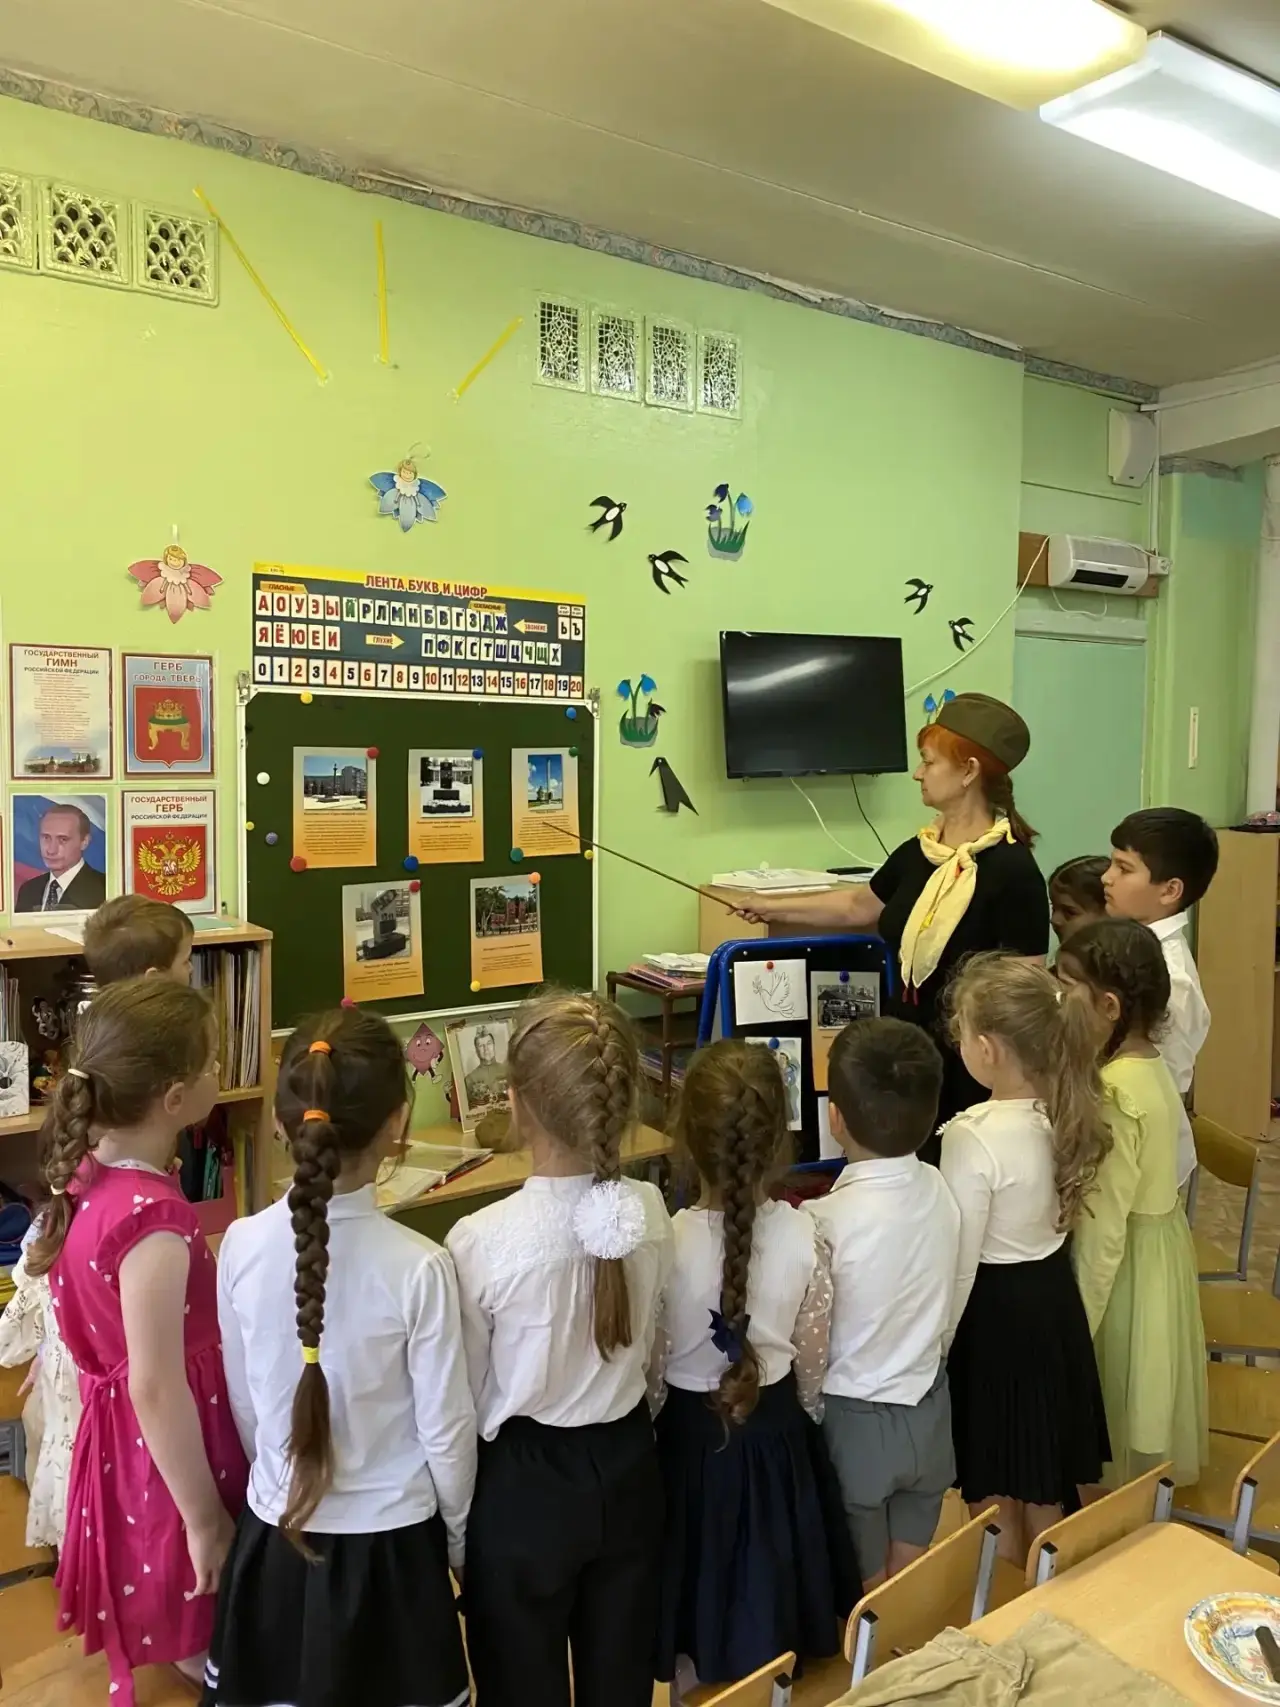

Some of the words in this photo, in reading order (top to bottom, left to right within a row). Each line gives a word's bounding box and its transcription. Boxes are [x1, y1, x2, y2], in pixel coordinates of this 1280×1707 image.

[366, 575, 404, 590] ЛЕНТА
[409, 580, 439, 594] БУКВ
[443, 584, 450, 594] И
[454, 584, 488, 597] ЦИФР
[259, 595, 268, 611] А
[276, 596, 286, 612] О
[295, 598, 304, 613] У
[312, 600, 320, 614] Э
[327, 601, 338, 616] Ы
[362, 604, 371, 619] Р
[377, 605, 386, 620] Л
[392, 607, 402, 622] М
[409, 608, 418, 623] Н
[425, 610, 433, 624] Б
[440, 611, 448, 625] В
[456, 612, 463, 627] Г
[469, 615, 477, 628] З
[483, 615, 492, 631] Д
[495, 616, 506, 631] Ж
[259, 627, 269, 642] Я
[276, 624, 284, 643] Ё
[292, 630, 305, 645] Ю
[312, 631, 320, 645] Е
[328, 632, 337, 646] И
[373, 636, 393, 644] ГЛУХИЕ
[24, 649, 99, 659] ГОСУДАРСТВЕННЫЙ
[425, 639, 433, 654] П
[438, 640, 449, 654] Ф
[455, 640, 463, 655] К
[470, 642, 477, 656] С
[484, 643, 492, 657] Т
[496, 644, 507, 658] Ш
[511, 645, 520, 661] Ц
[525, 646, 533, 660] Ч
[537, 647, 548, 663] Щ
[552, 648, 559, 662] Х
[46, 659, 77, 667] ГИМН
[154, 662, 182, 671] ГЕРБ
[259, 663, 266, 676] 0
[278, 664, 283, 676] 1
[295, 665, 302, 677] 2
[313, 666, 320, 678] 3
[330, 667, 337, 679] 4
[348, 668, 354, 679] 5
[364, 669, 371, 681] 6
[381, 670, 387, 682] 7
[397, 671, 403, 683] 8
[413, 672, 419, 684] 9
[426, 673, 437, 685] 10
[443, 674, 452, 685] 11
[458, 675, 468, 686] 12
[472, 675, 482, 686] 13
[487, 676, 497, 687] 14
[501, 677, 511, 688] 15
[516, 678, 525, 689] 16
[530, 678, 540, 689] 17
[544, 679, 553, 690] 18
[558, 680, 567, 691] 19
[571, 681, 582, 691] 20
[156, 803, 183, 812] ГЕРБ
